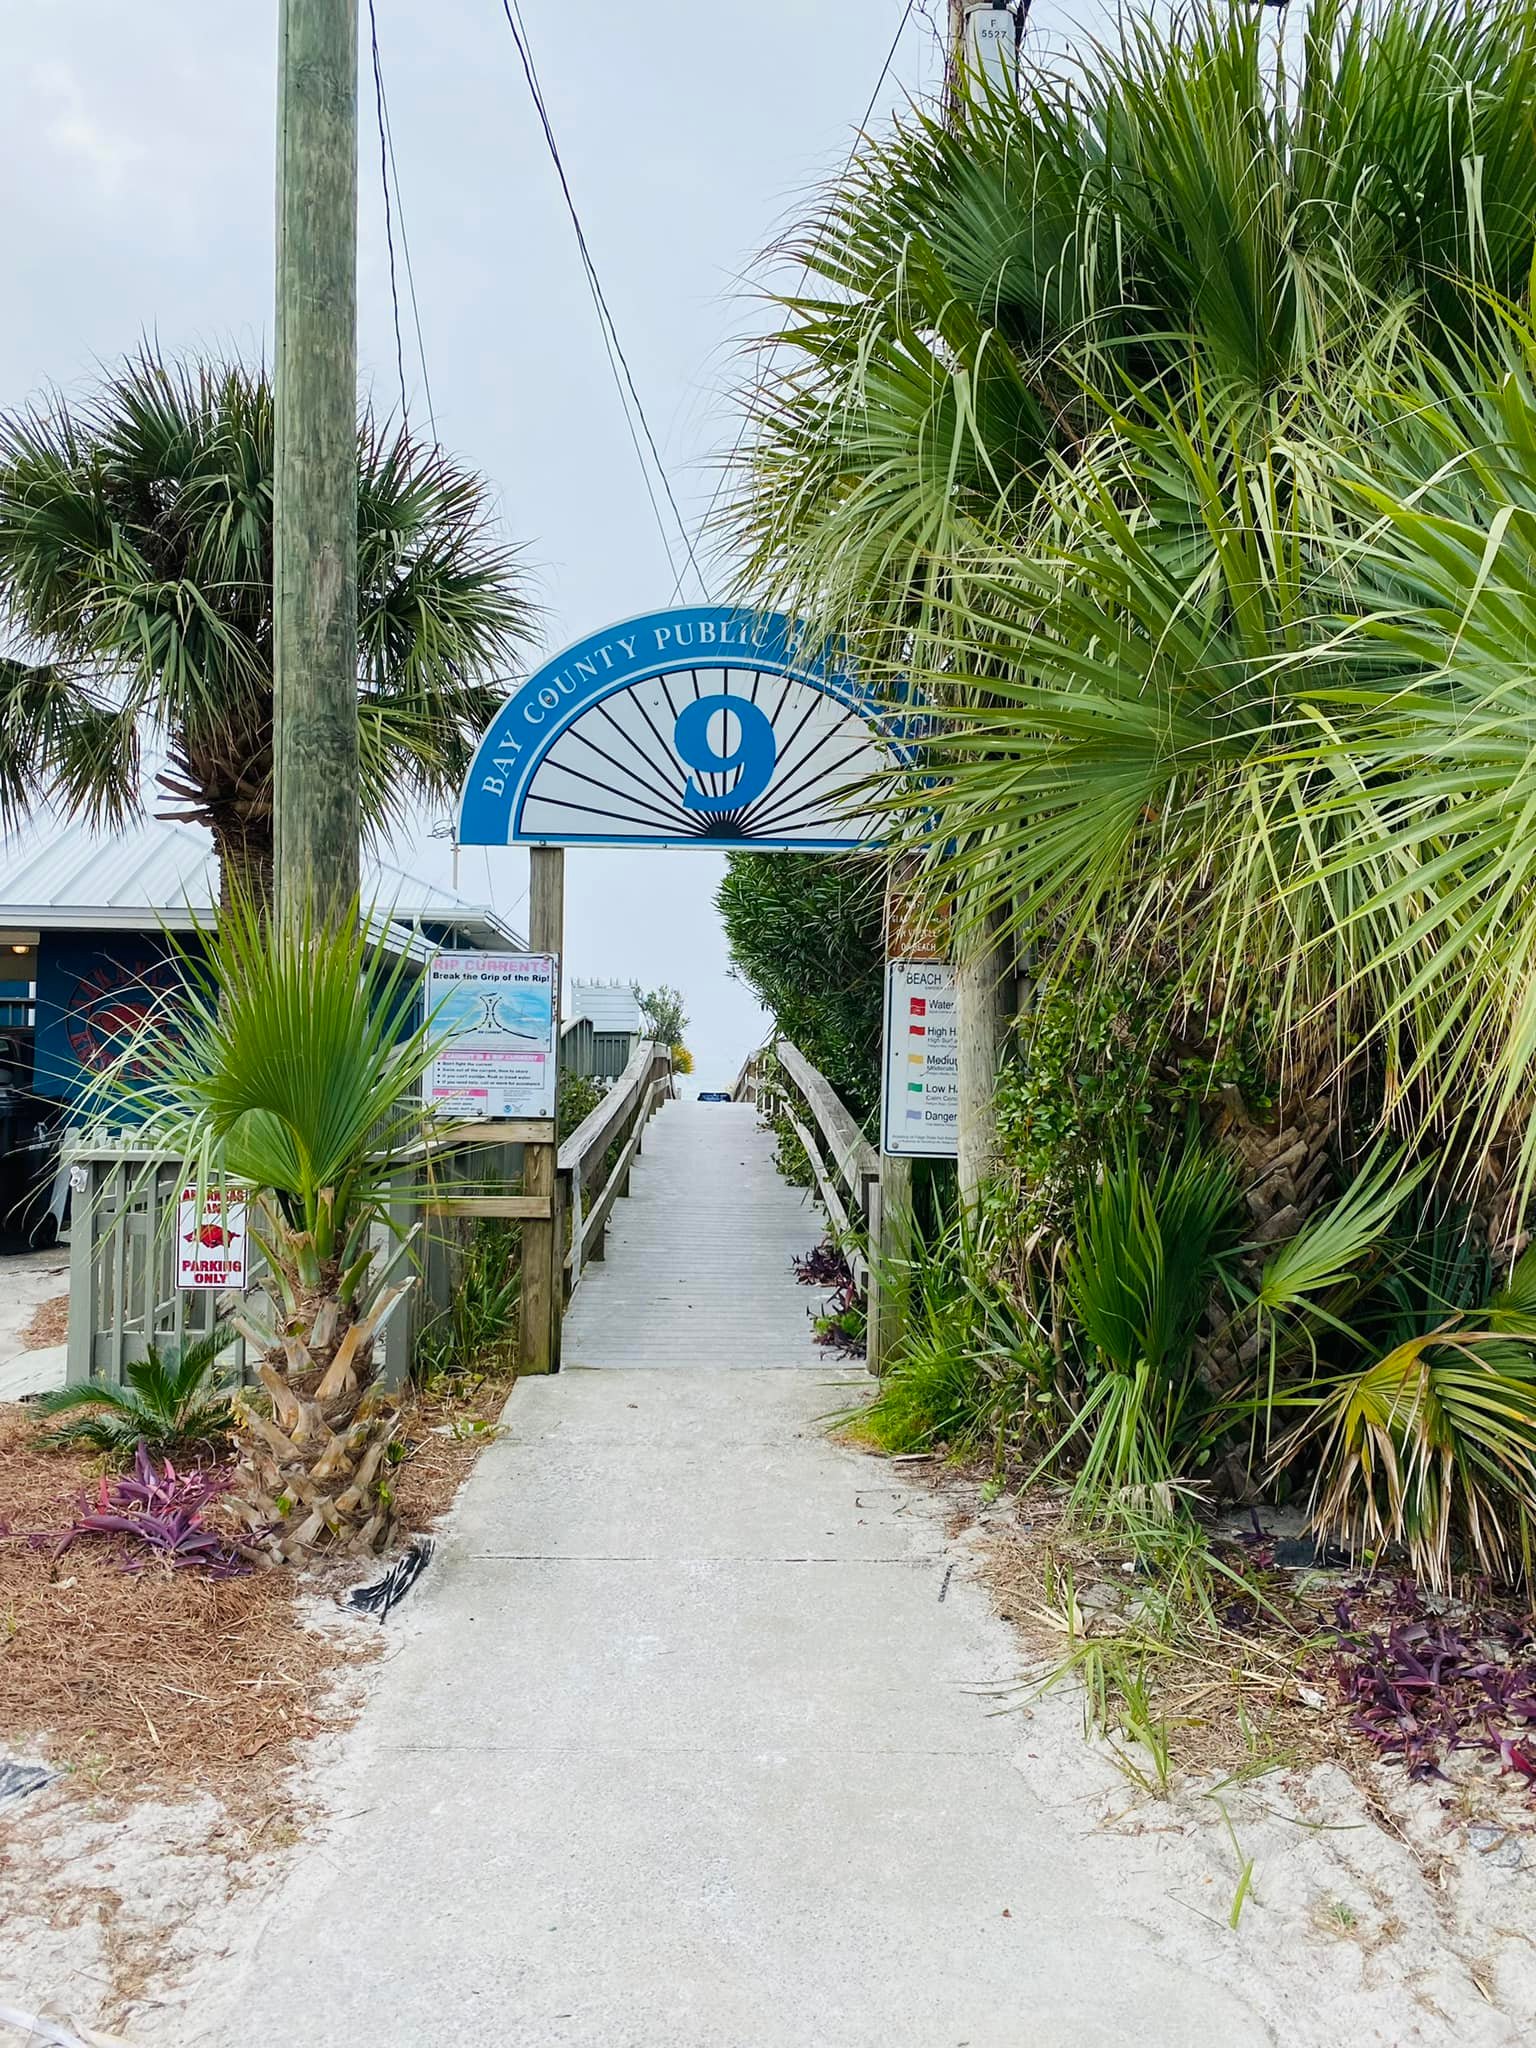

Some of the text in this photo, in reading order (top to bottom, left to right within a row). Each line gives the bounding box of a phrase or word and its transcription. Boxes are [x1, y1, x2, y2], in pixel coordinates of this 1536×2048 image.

[990, 19, 997, 27] F
[981, 29, 1007, 39] 5527
[481, 621, 769, 798] BAY COUNTY PUBLIC
[674, 694, 776, 812] 9
[434, 959, 550, 972] RIP CURRENTS
[433, 972, 460, 980] Break
[481, 973, 500, 982] Grip
[514, 974, 530, 982] the
[533, 974, 550, 983] Rip!
[906, 973, 941, 985] BEACH
[928, 999, 954, 1010] Water
[927, 1026, 947, 1038] High
[926, 1055, 957, 1065] Mediu
[926, 1083, 946, 1093] Low
[195, 1273, 227, 1284] ONLY
